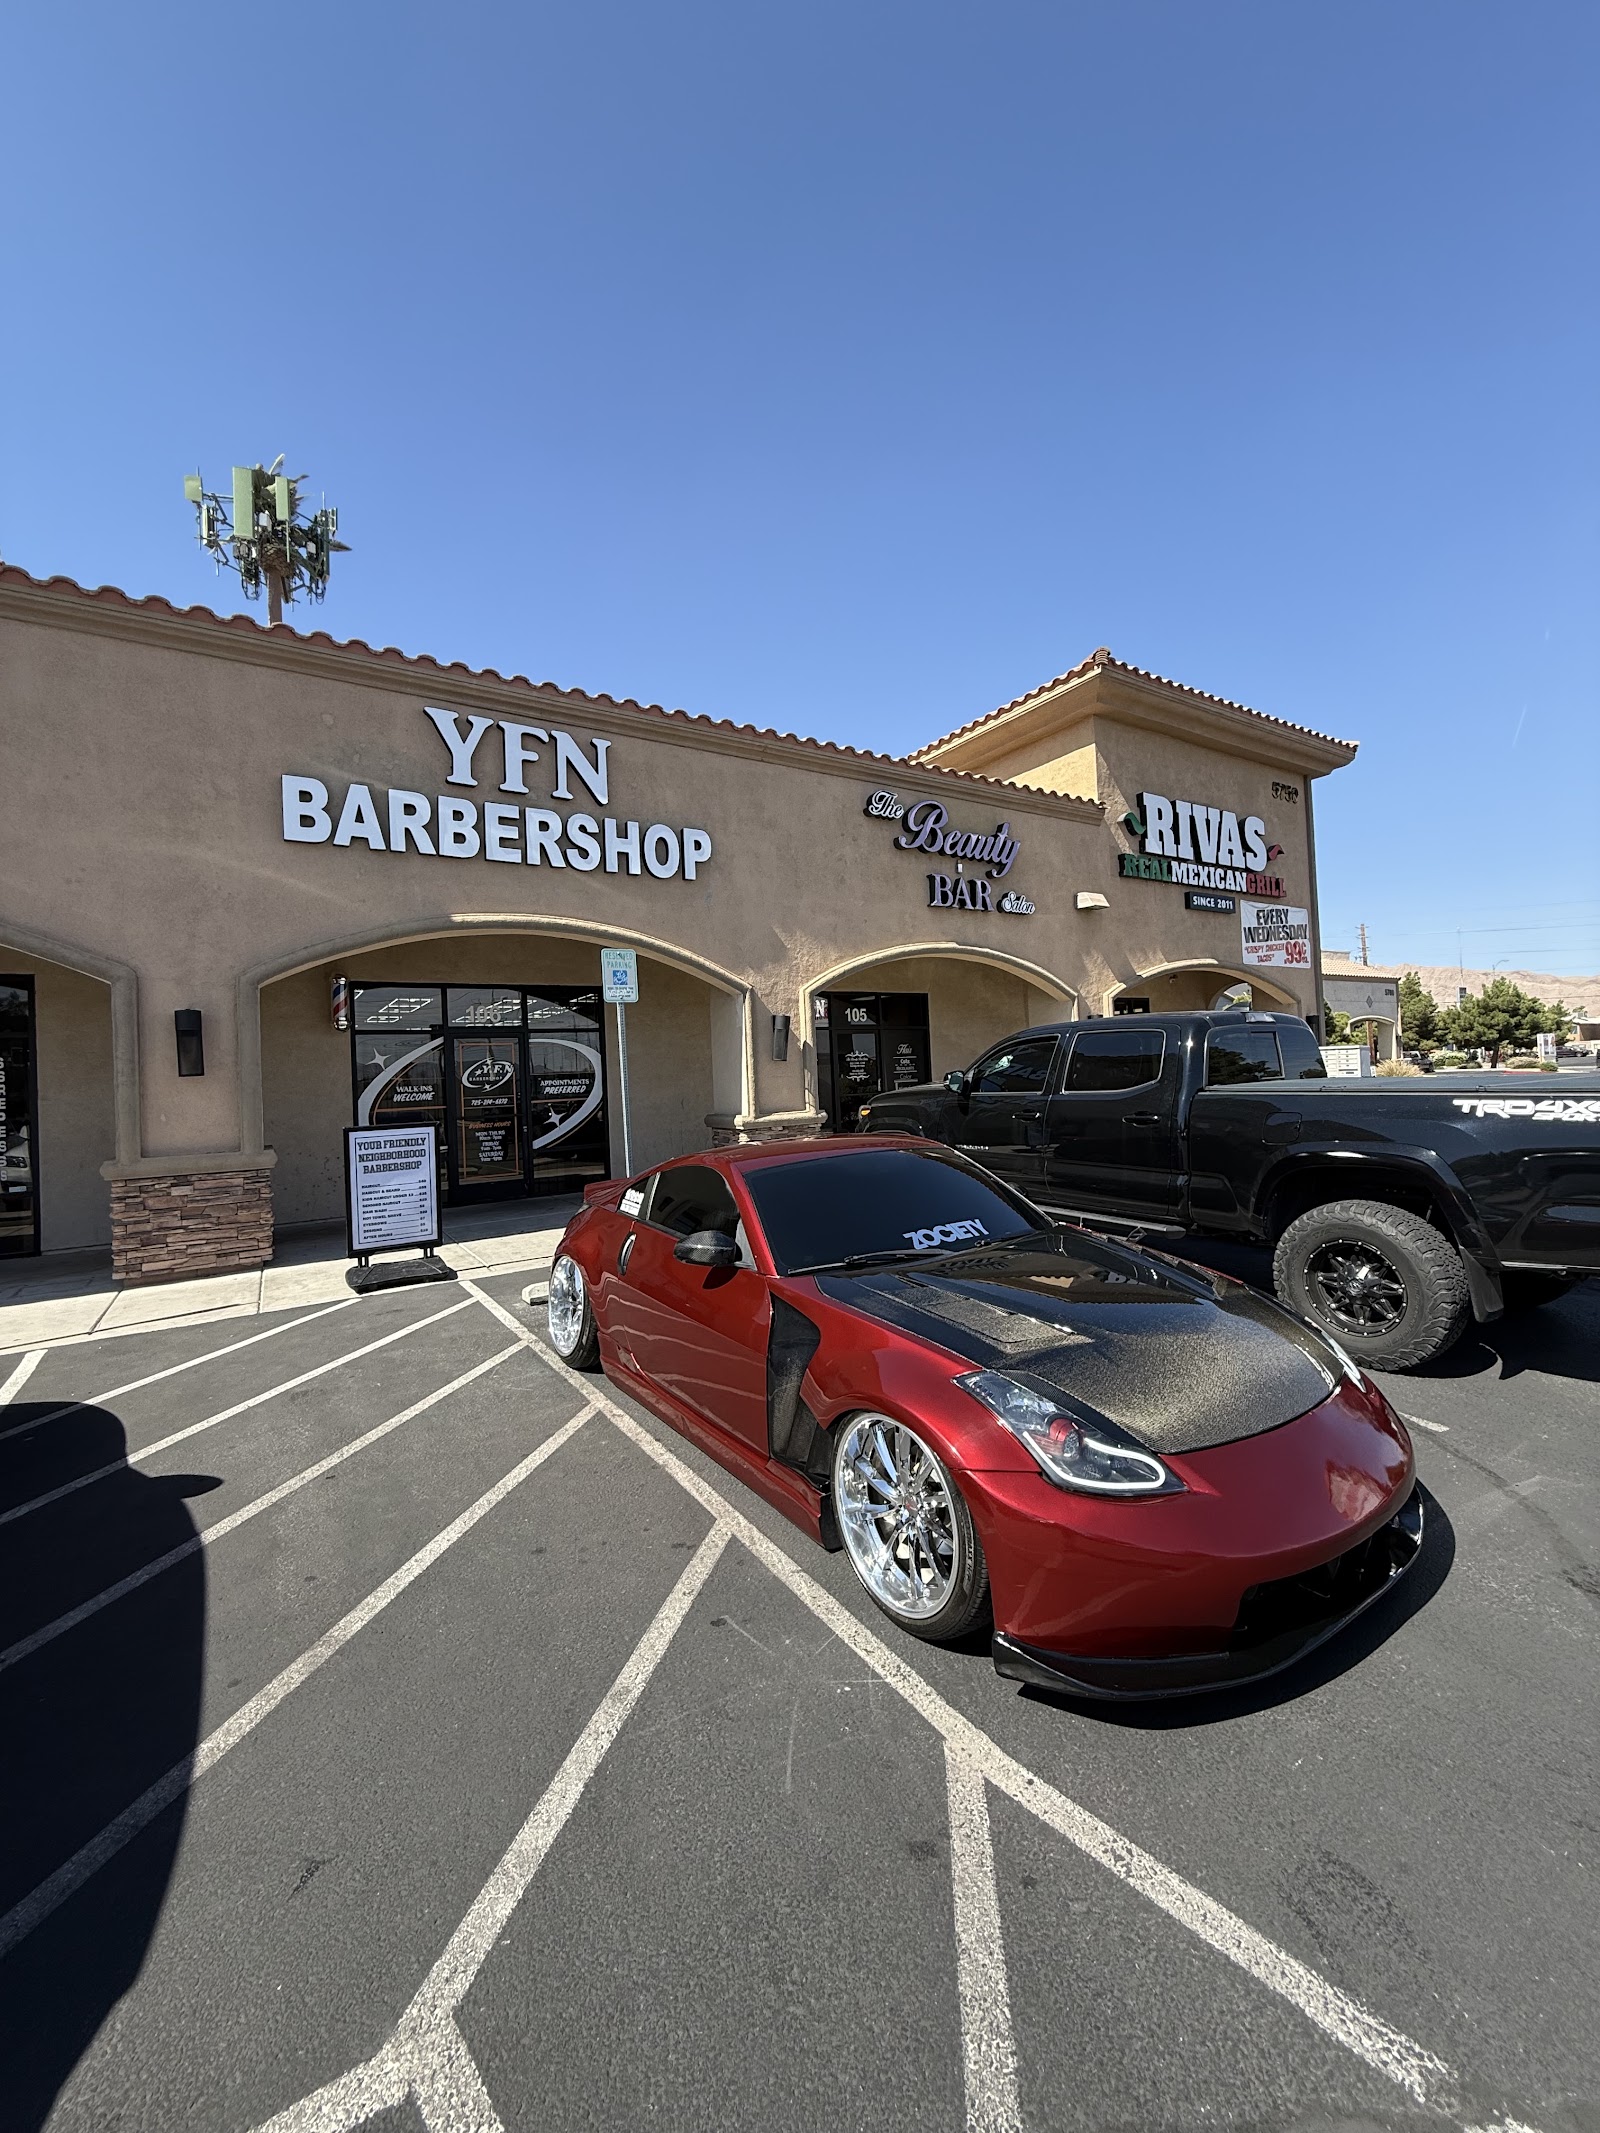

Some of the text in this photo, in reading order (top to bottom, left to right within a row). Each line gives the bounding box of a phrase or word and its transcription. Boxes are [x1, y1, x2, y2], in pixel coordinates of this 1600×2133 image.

[424, 707, 611, 805] YFN
[867, 790, 905, 819] The
[282, 774, 712, 881] BARBERSHOP
[1142, 791, 1268, 872] RIVAS
[897, 800, 1021, 878] Beauty
[1121, 852, 1288, 898] REAL MEXICAN GRILL
[929, 873, 995, 911] BAR
[1000, 891, 1036, 915] Salon
[1192, 895, 1234, 910] SINCE 2011
[1256, 908, 1289, 926] EVERY
[1243, 924, 1308, 943] WEDNESDAY
[606, 960, 633, 969] PARKING
[465, 1005, 502, 1023] 106
[845, 1007, 867, 1022] 105
[396, 1085, 433, 1093] WALK-INS
[540, 1079, 590, 1087] APPOINTMENTS
[543, 1085, 587, 1094] PREFERRED
[393, 1092, 435, 1102] WELCOME
[1452, 1098, 1536, 1119] TRD
[1531, 1111, 1600, 1122] SPOR
[357, 1137, 427, 1151] YOUR FRIENDLY
[358, 1148, 427, 1163] NEIGHBORHOOD
[478, 1150, 505, 1158] SATURDAY
[363, 1160, 422, 1174] BARBERSHOP
[902, 1218, 990, 1250] ZOCIETY
